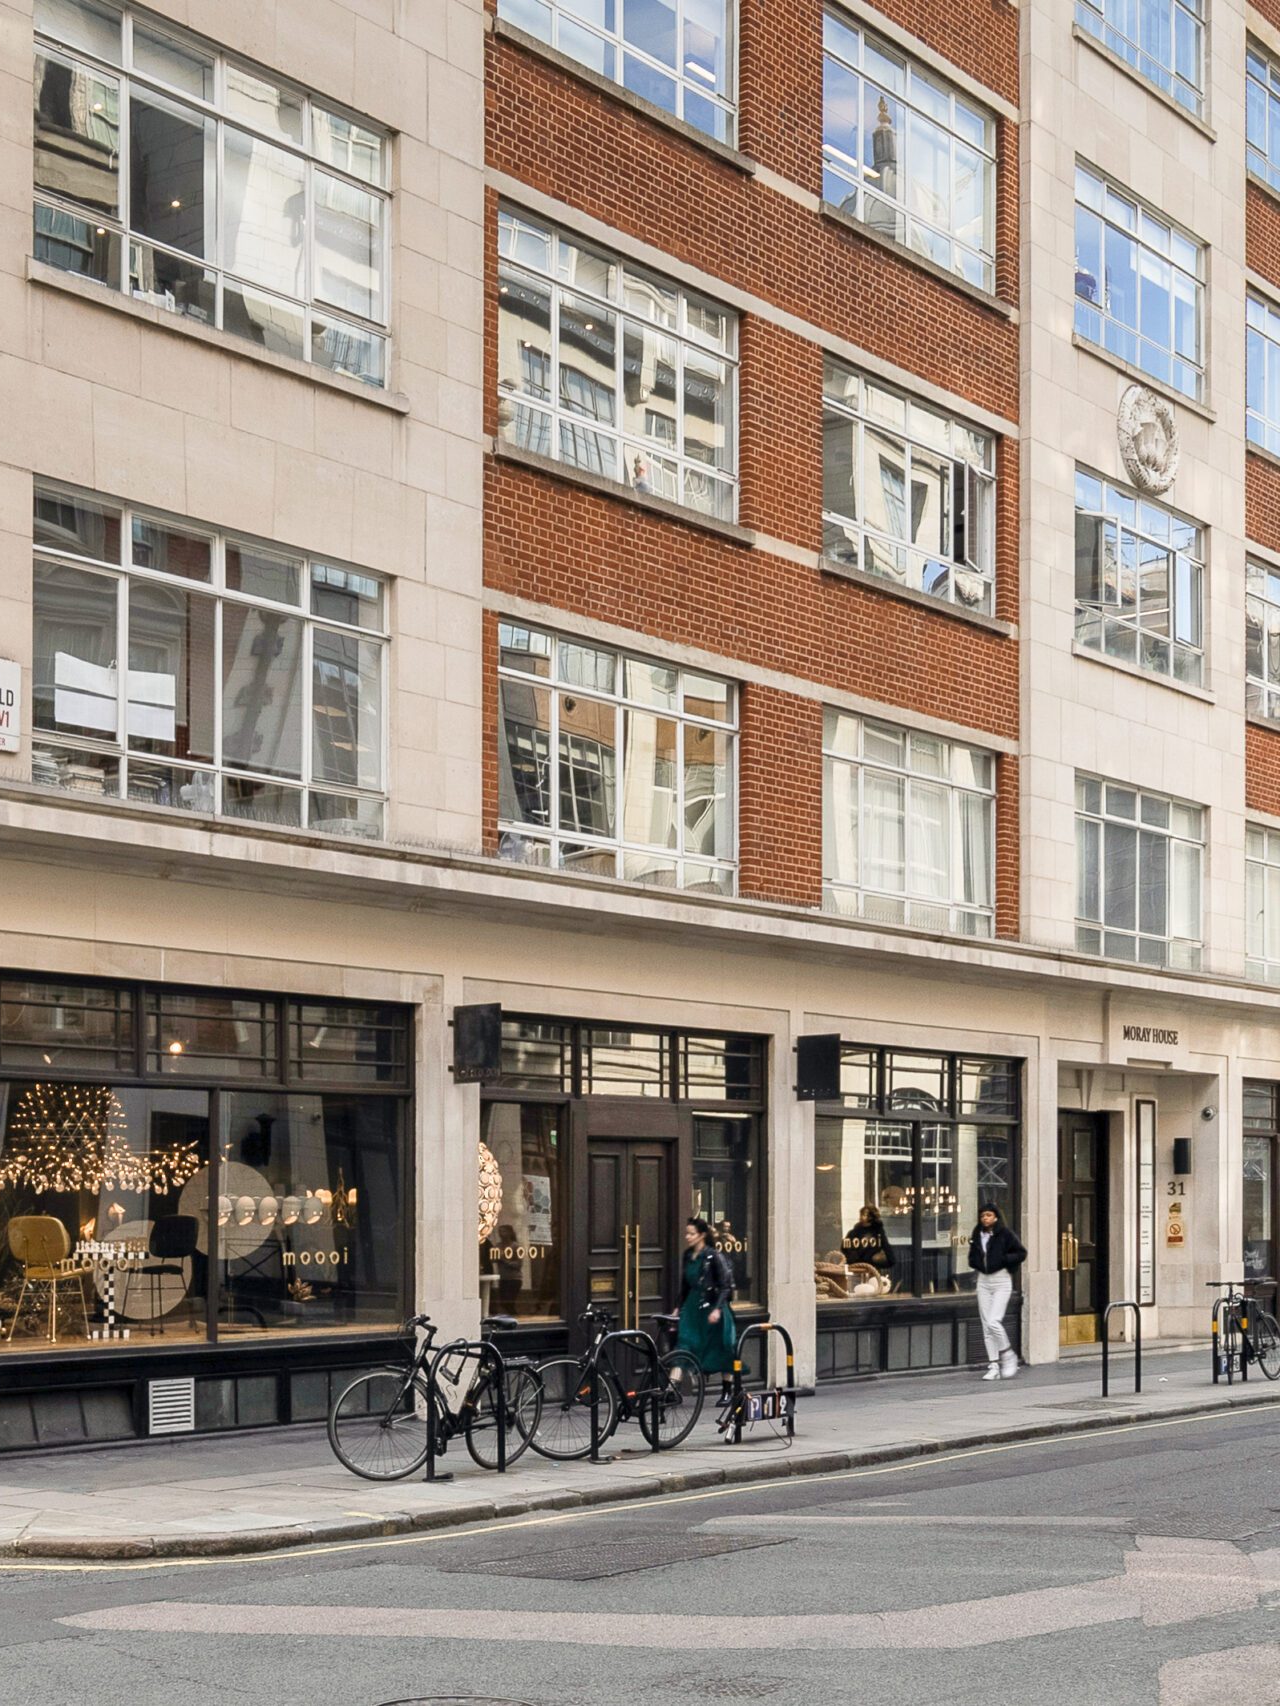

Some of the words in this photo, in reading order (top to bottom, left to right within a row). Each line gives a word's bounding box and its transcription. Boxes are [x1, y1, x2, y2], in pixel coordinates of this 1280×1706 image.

[1123, 1025, 1151, 1042] MORAY
[1152, 1028, 1178, 1045] HOUSE
[1168, 1181, 1186, 1196] 31
[715, 1237, 748, 1253] oooi
[843, 1234, 881, 1249] moooi
[283, 1247, 348, 1266] moooi
[490, 1246, 545, 1260] moooi
